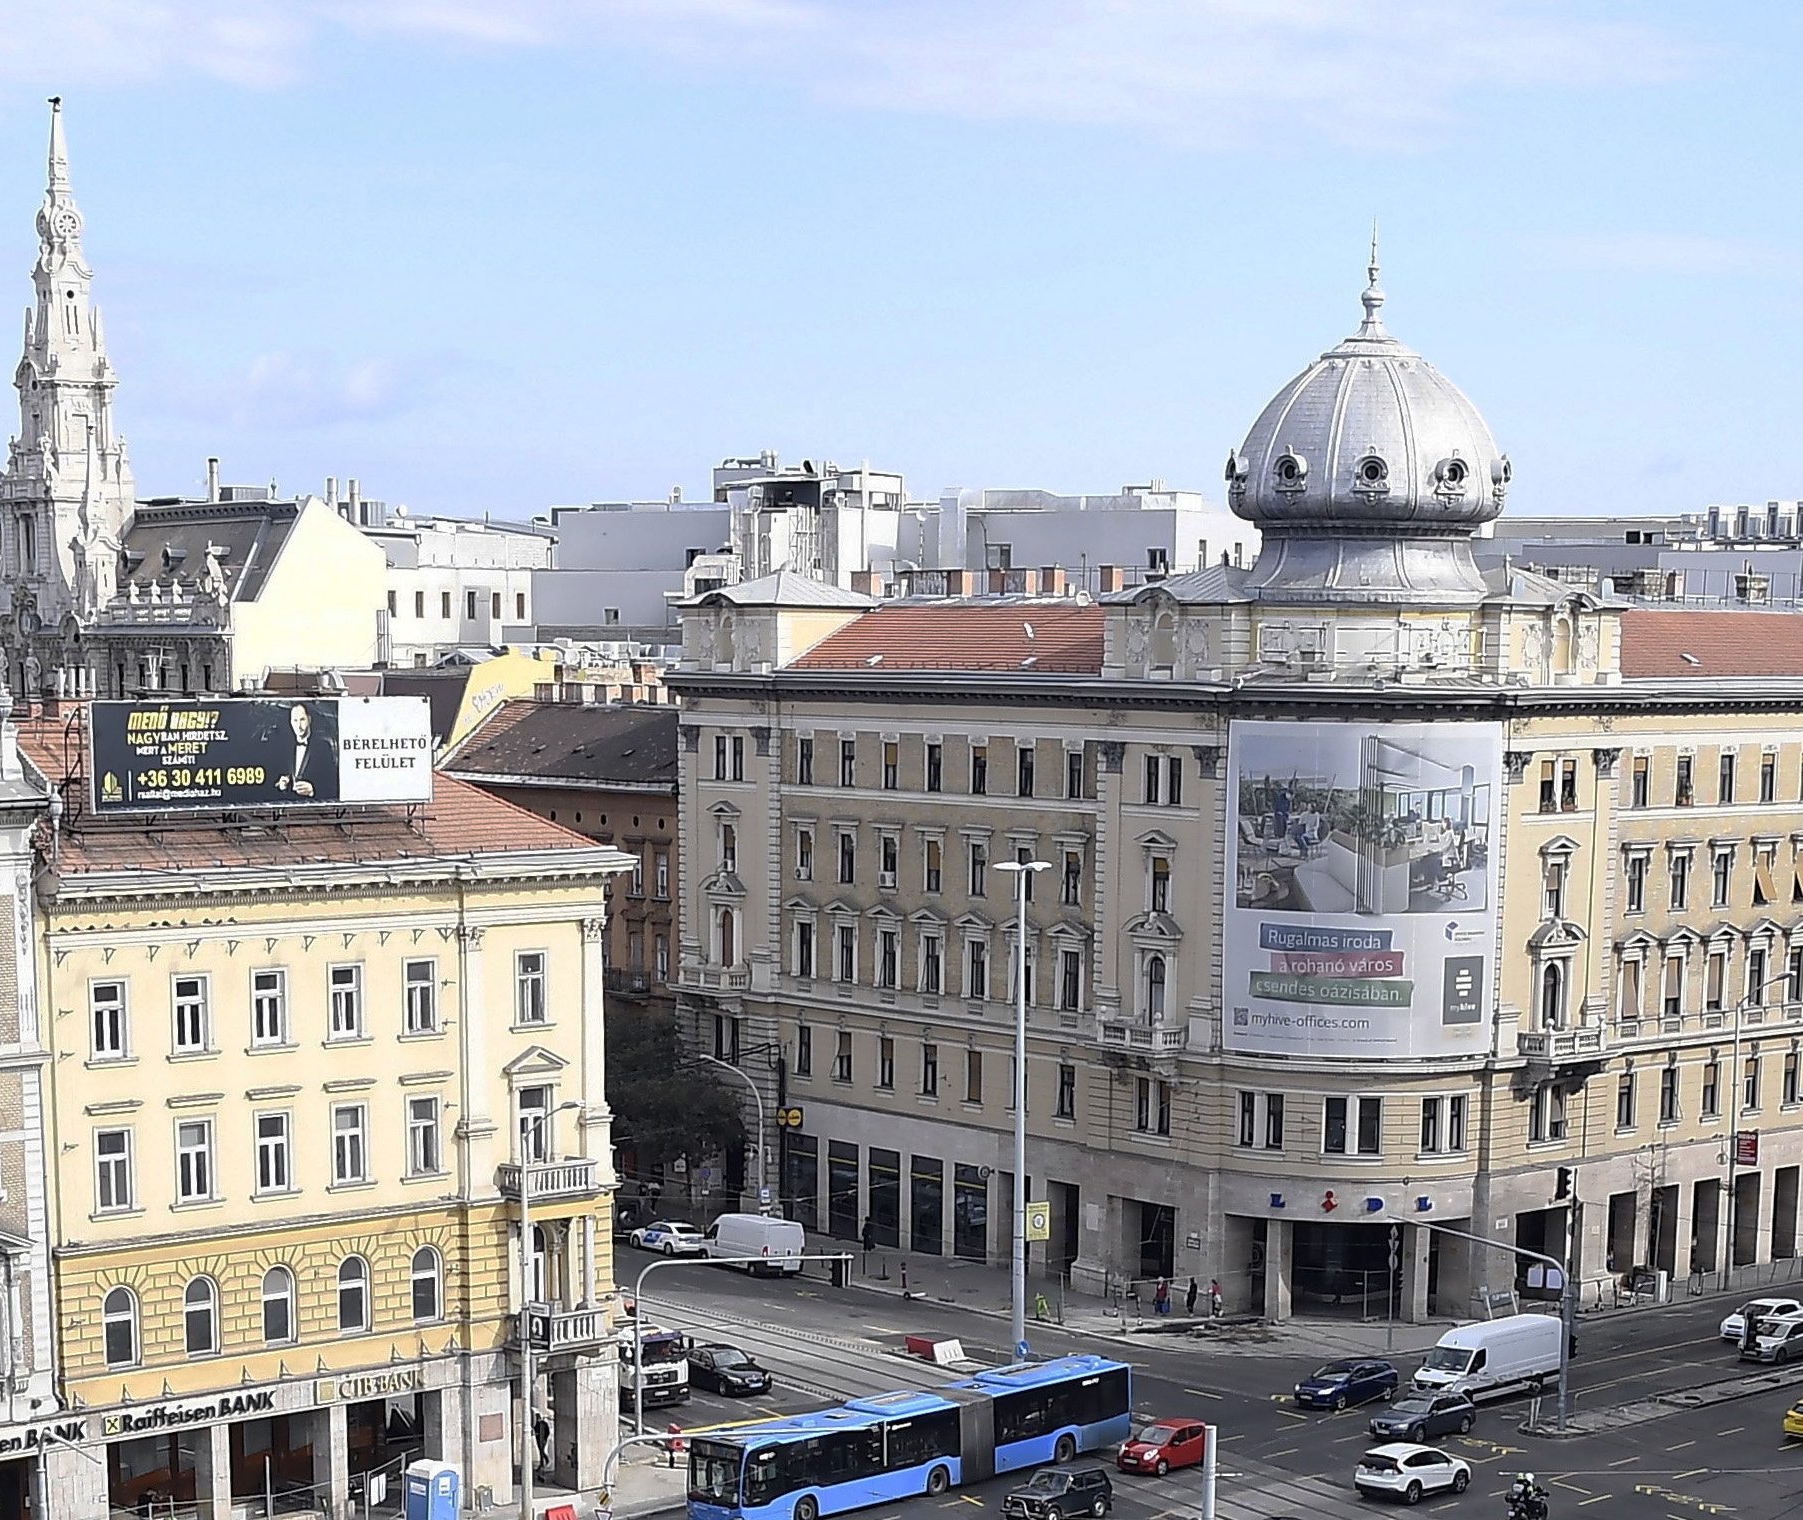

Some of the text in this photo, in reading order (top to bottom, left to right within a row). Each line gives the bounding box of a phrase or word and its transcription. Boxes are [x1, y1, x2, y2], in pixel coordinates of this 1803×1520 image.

[160, 746, 168, 755] A
[355, 753, 416, 769] FELÜLET
[137, 766, 265, 788] +36 30 411 6989
[1268, 929, 1382, 949] Rugalmas iroda
[1279, 958, 1394, 973] a rohanó város
[1256, 979, 1403, 1001] csendes oázisában.
[1251, 1013, 1370, 1030] myhive-offices.com
[120, 1390, 277, 1434] Raiffeisen BANK
[24, 1420, 88, 1450] BANK
